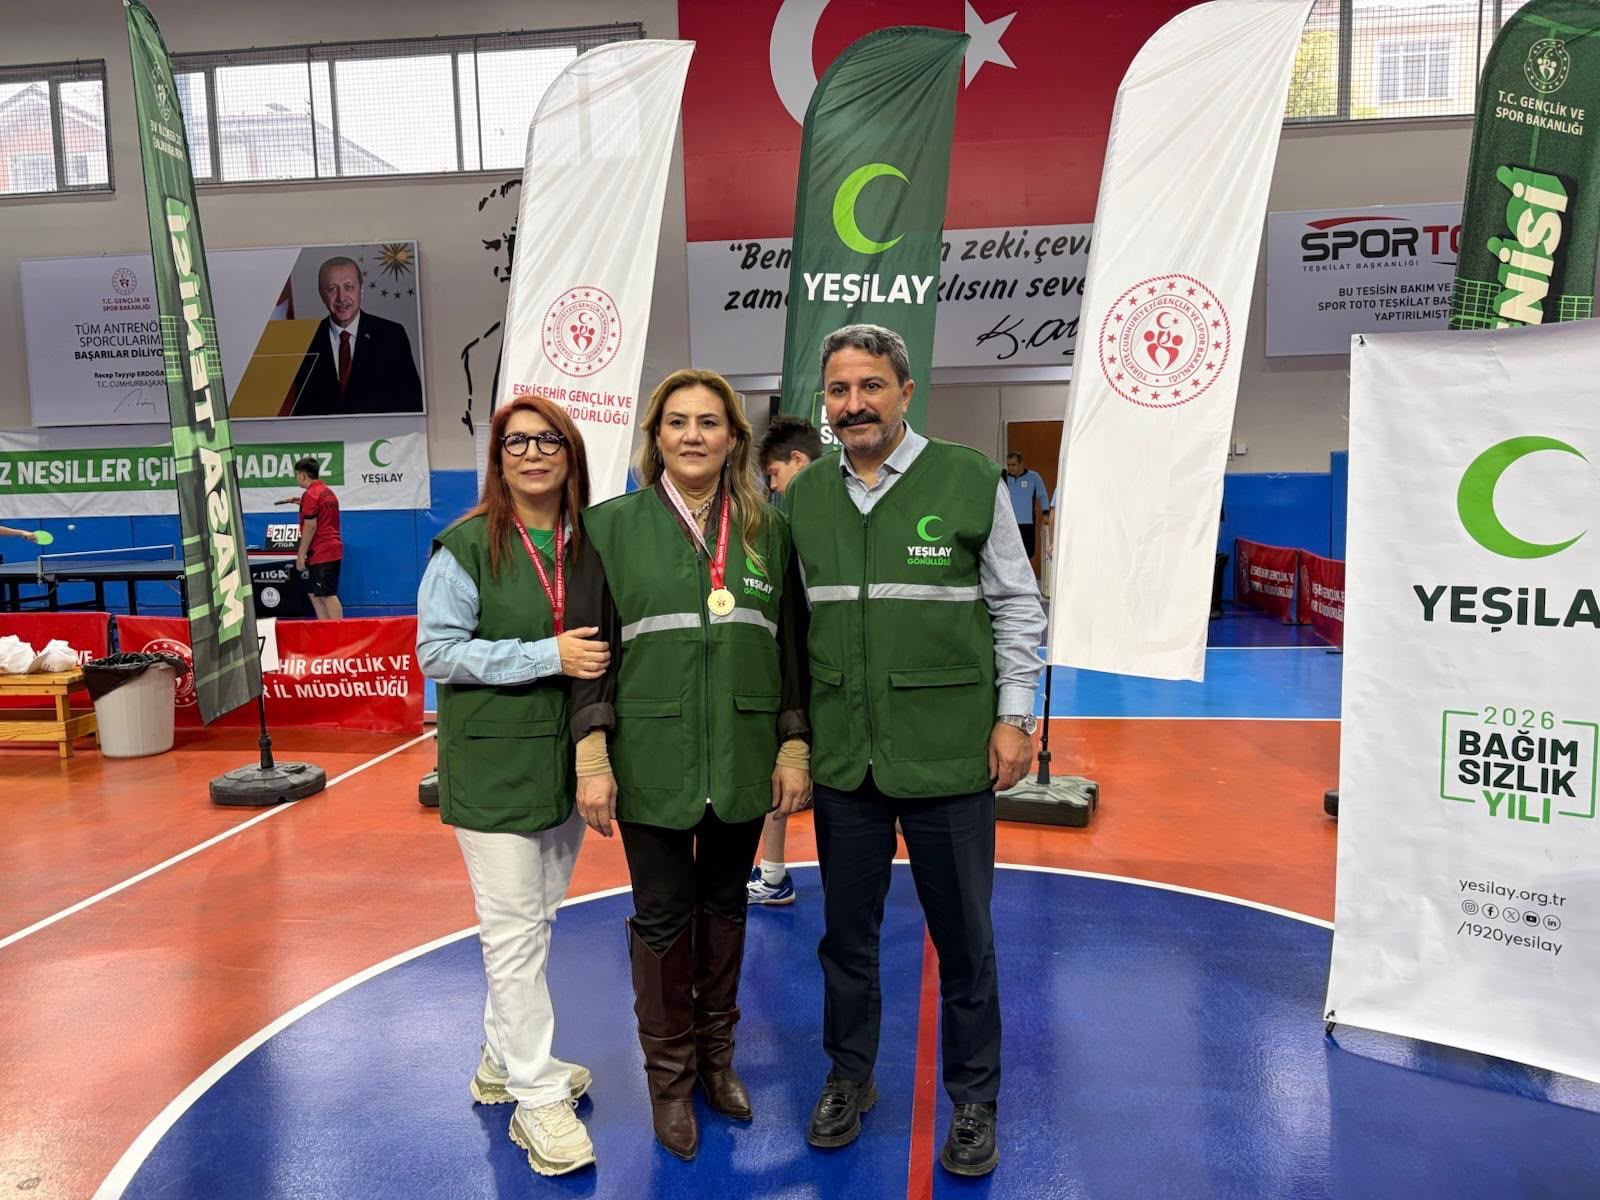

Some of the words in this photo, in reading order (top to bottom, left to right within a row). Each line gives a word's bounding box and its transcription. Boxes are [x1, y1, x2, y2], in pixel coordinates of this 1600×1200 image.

[1498, 90, 1517, 105] T.C.
[1520, 96, 1568, 116] GENÇLİK
[1570, 107, 1585, 120] VE
[1495, 106, 1524, 123] SPOR
[1526, 113, 1583, 136] BAKANLIĞI
[1302, 263, 1351, 273] TEŞKİLAT
[1356, 260, 1419, 270] BAŞKANLIĞI
[1496, 182, 1568, 329] NİSİ
[724, 288, 789, 311] zam
[1339, 288, 1353, 297] BU
[1356, 284, 1397, 296] TESİSİN
[1401, 283, 1434, 295] BAKIM
[1437, 282, 1451, 292] VE
[1318, 301, 1346, 311] SPOR
[1349, 299, 1376, 310] TOTO
[1379, 296, 1430, 309] TEŞKİLAT
[75, 323, 100, 335] TÜM
[104, 320, 160, 334] ANTRENÖ
[80, 334, 161, 348] SPORCULARIM
[74, 349, 129, 361] BAŞARILAR
[568, 390, 615, 407] GENÇLİK
[617, 395, 632, 408] VE
[562, 404, 629, 425] ÜDÜRLÜĞÜ
[17, 458, 131, 485] NESİLLER
[273, 528, 284, 540] 21
[287, 527, 298, 540] 21
[311, 653, 384, 678] GENÇLİK
[389, 655, 410, 671] VE
[273, 679, 292, 698] İL
[295, 676, 409, 699] MÜDÜRLÜĞÜ
[1483, 706, 1555, 730] 2026
[1458, 729, 1579, 767] BAĞIM
[1458, 759, 1577, 798] SIZLIK
[1482, 790, 1552, 824] YILI
[1459, 879, 1567, 907] yesilay.org.tr
[1457, 921, 1563, 956] /1920yesilay
